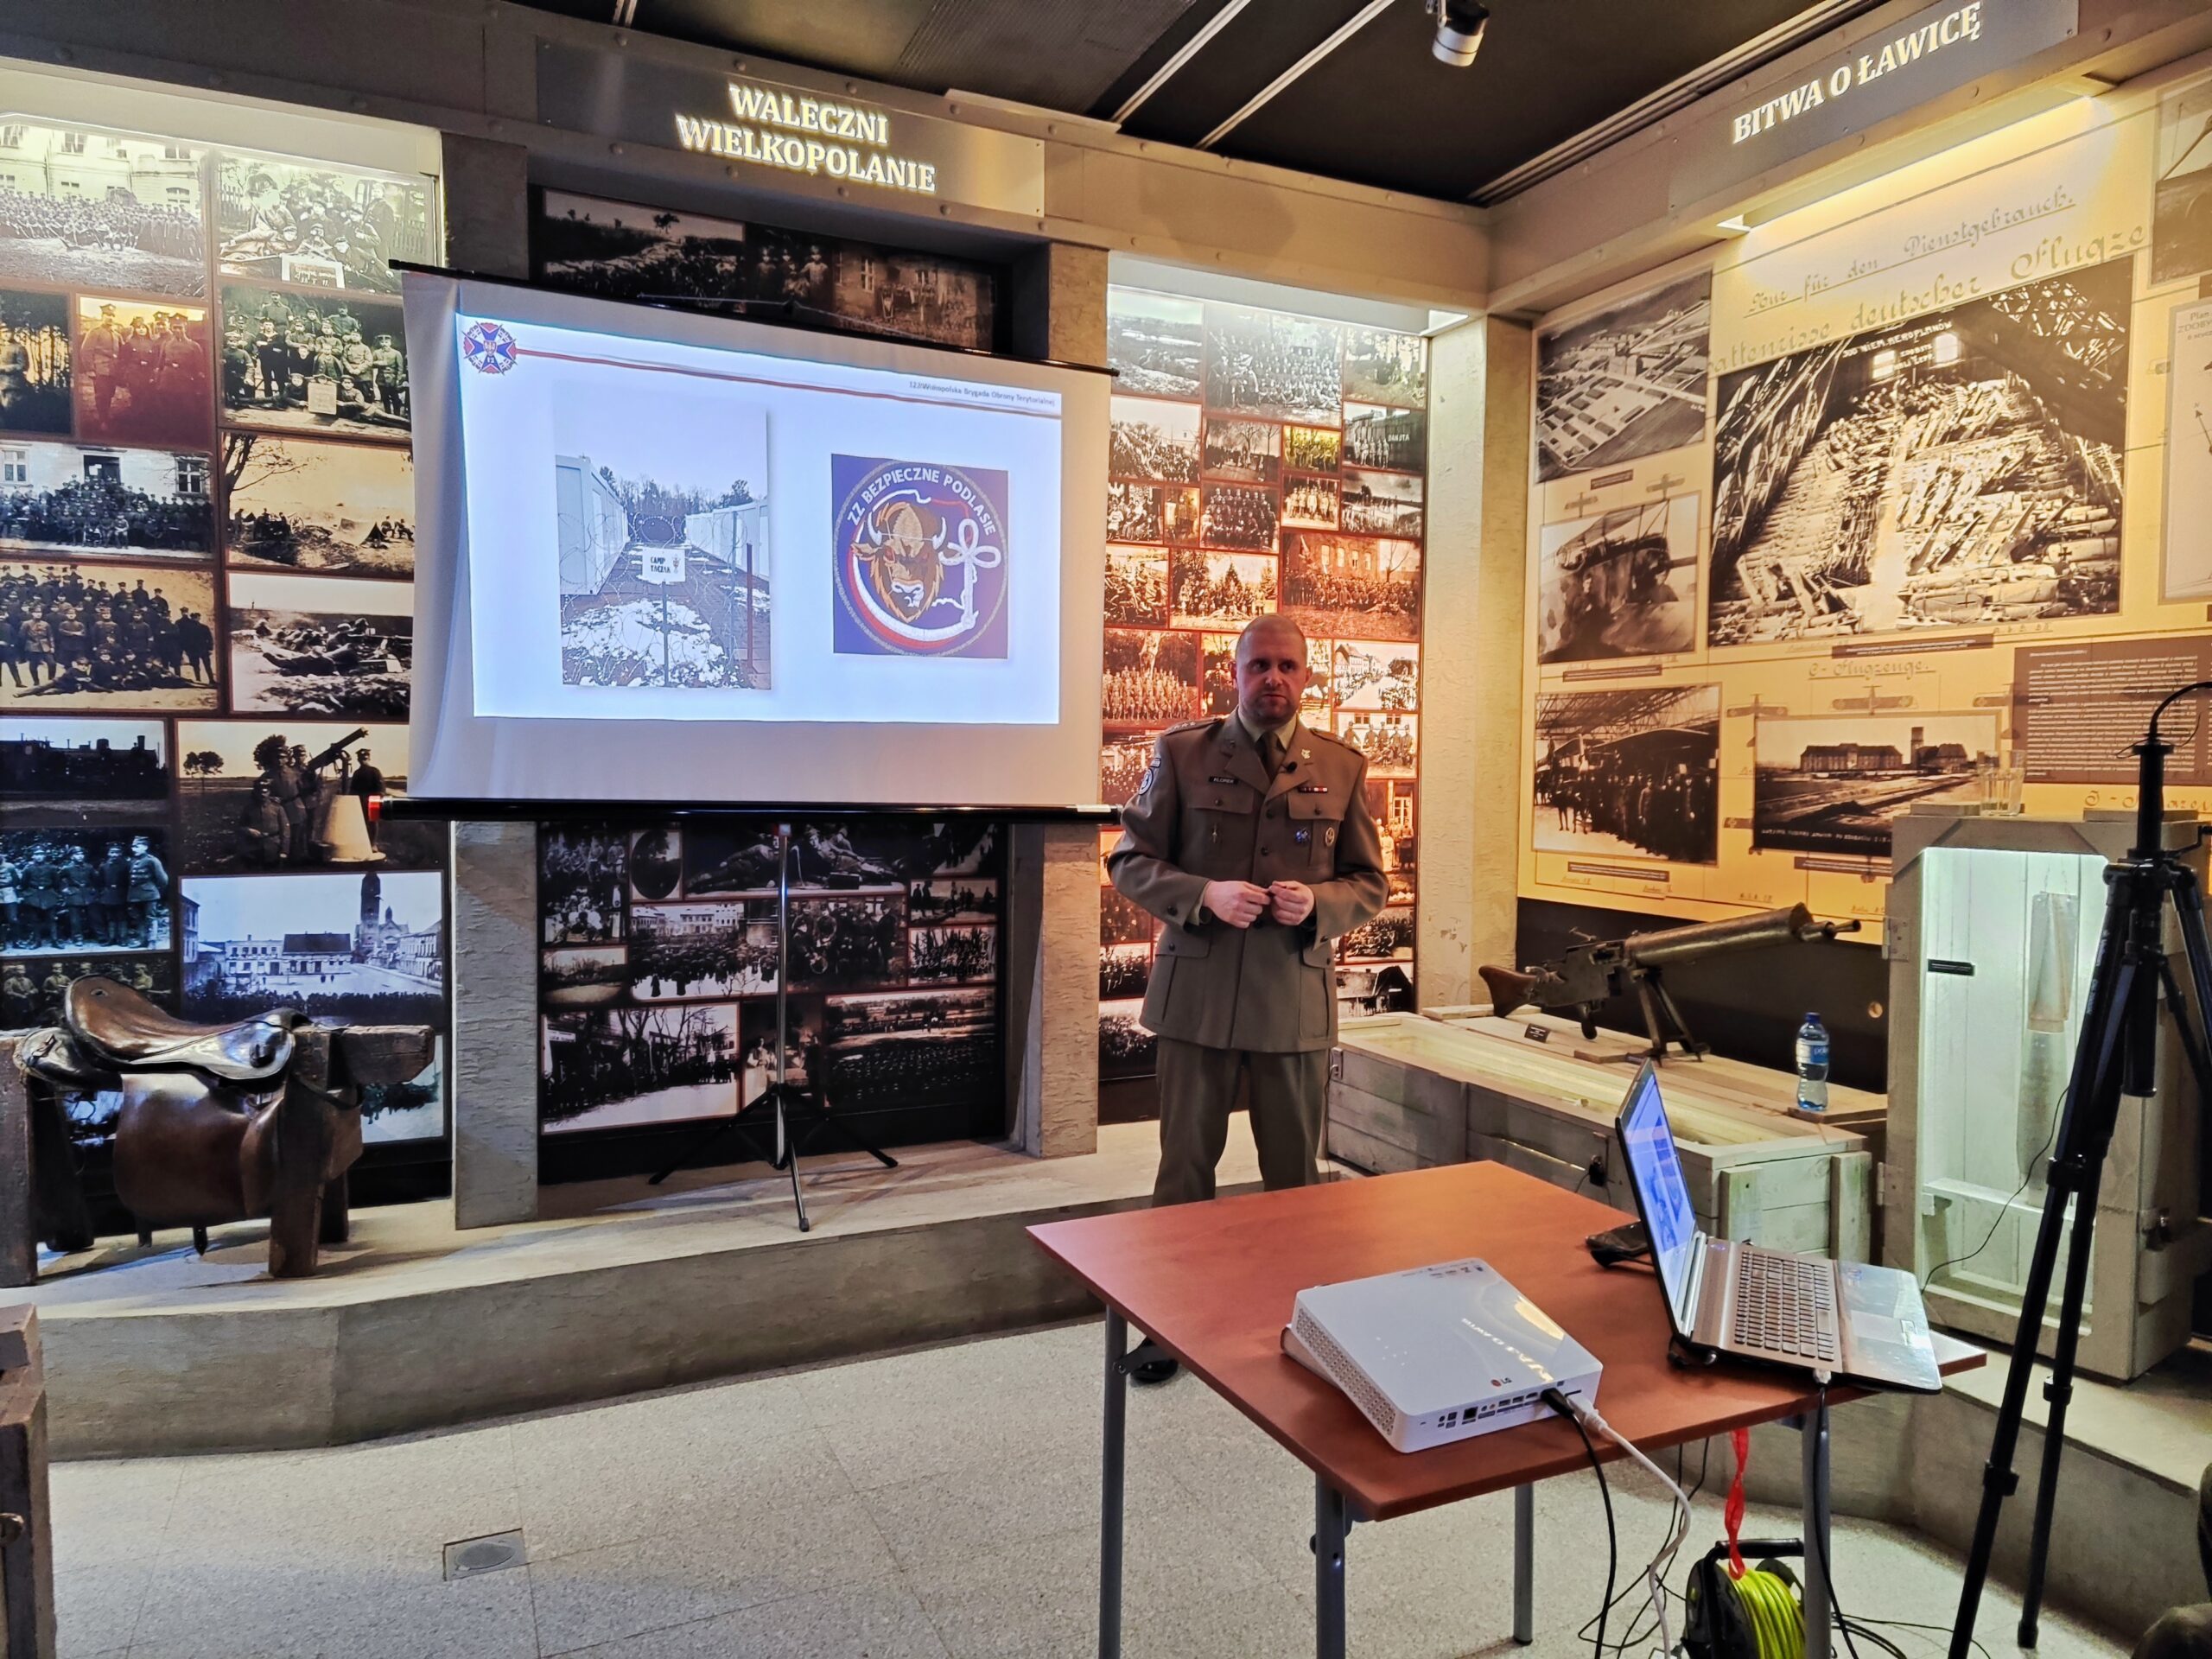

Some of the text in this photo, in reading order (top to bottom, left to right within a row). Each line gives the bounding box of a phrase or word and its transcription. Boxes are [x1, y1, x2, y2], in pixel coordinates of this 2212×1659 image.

[1732, 1, 1984, 144] BITWA O ŁAWICĘ
[728, 82, 889, 145] WALECZNI
[675, 114, 937, 194] WIELKOPOLANIE
[1847, 259, 1878, 279] den
[1851, 273, 1981, 330] deutscher
[963, 387, 989, 398] Brygada
[991, 391, 1014, 402] Obrony
[847, 467, 996, 537] ZZ BEZPIECZNE PODLASIE
[651, 556, 665, 565] CAMP
